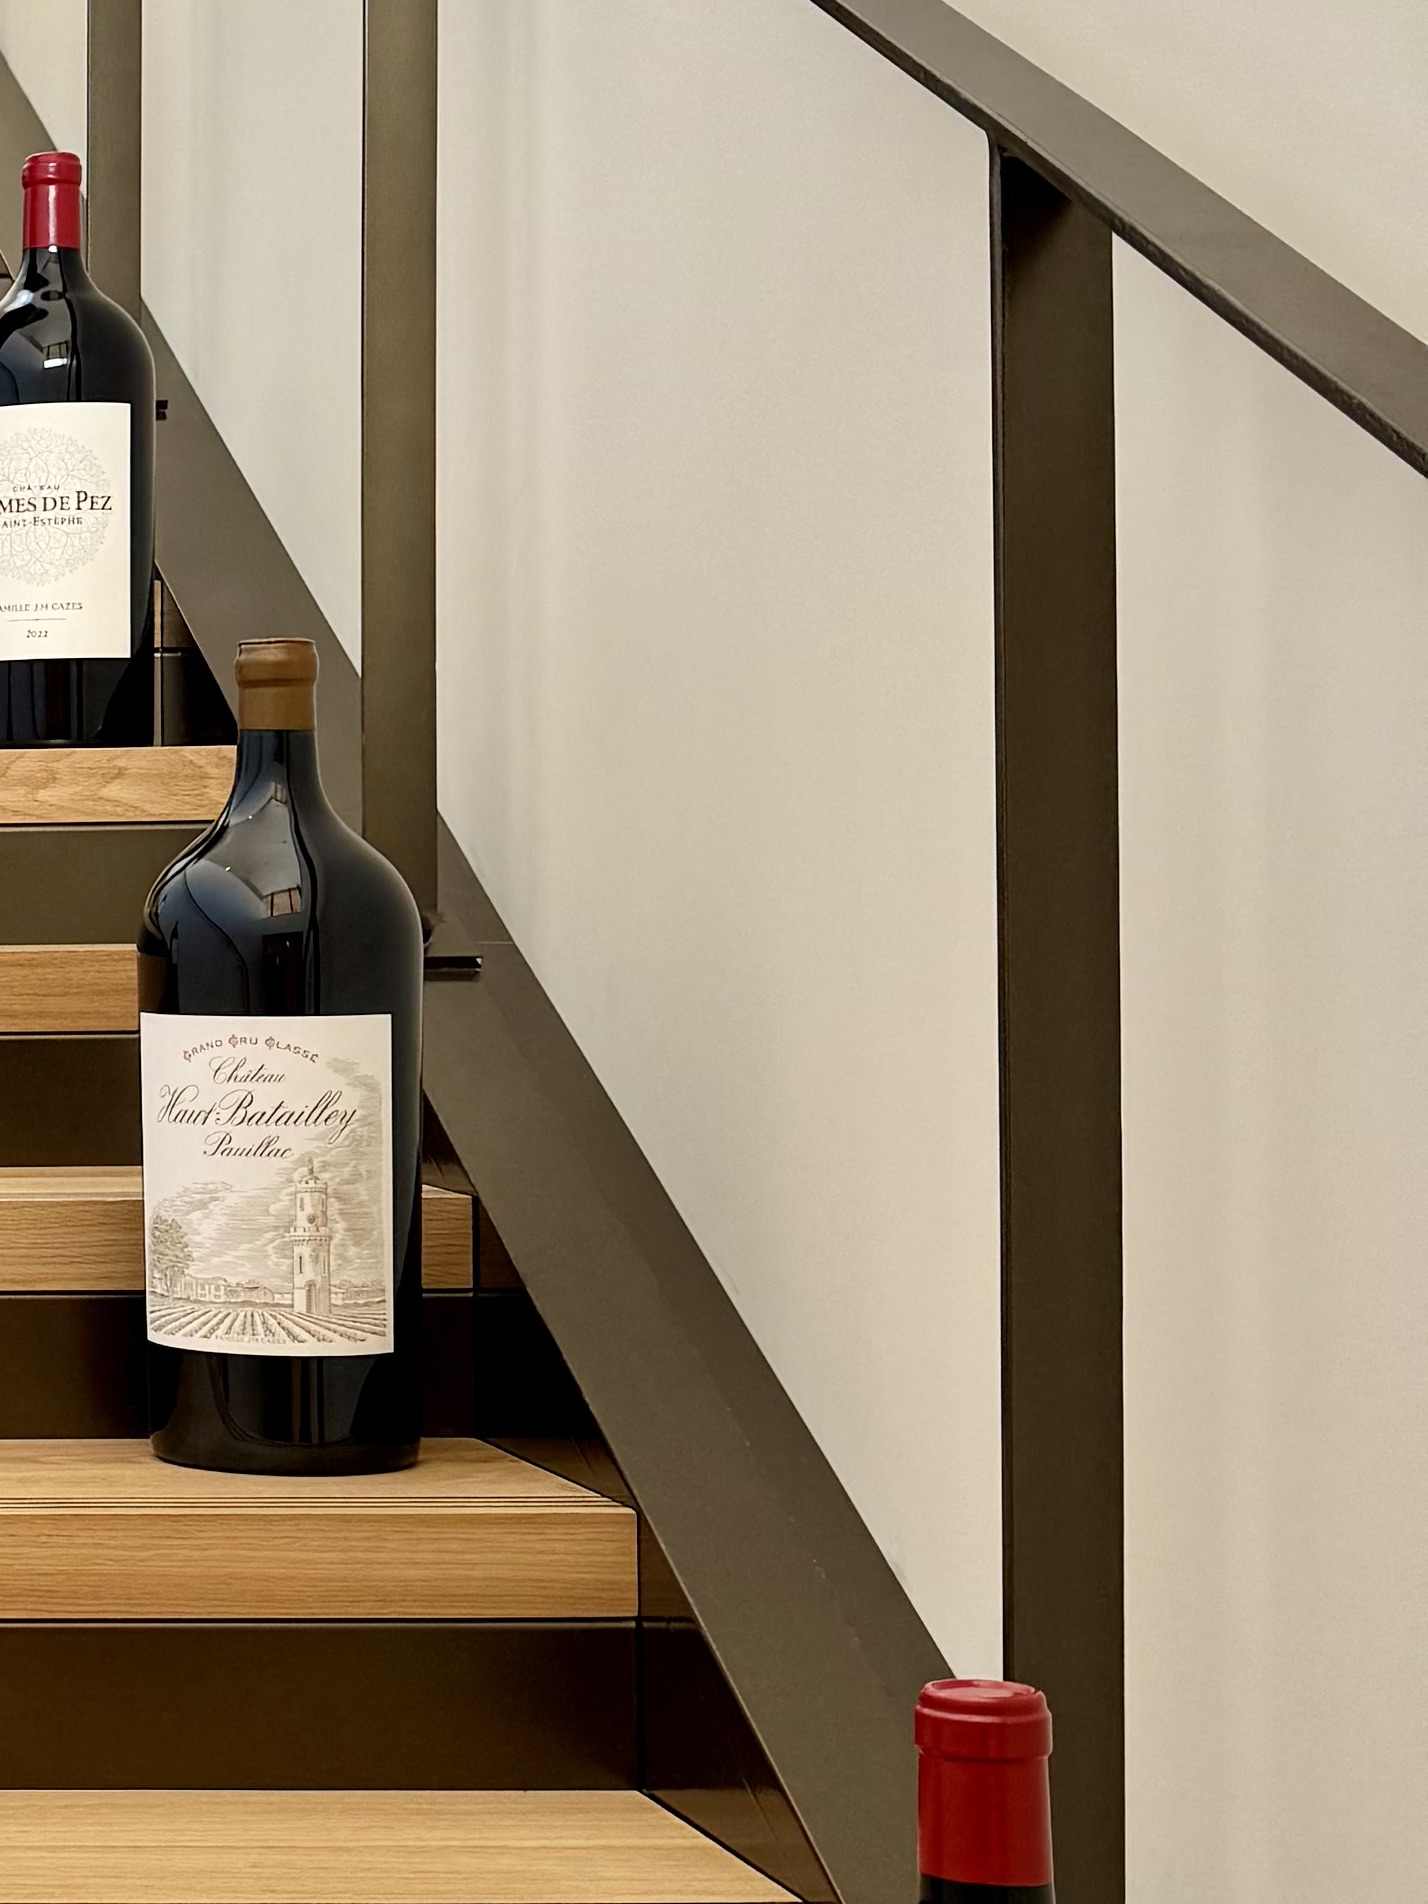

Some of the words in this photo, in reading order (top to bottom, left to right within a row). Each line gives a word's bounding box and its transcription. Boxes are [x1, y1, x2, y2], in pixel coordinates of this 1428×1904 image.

[42, 496, 70, 512] DE
[75, 490, 112, 510] PEZ
[26, 630, 48, 638] 2022
[183, 1039, 223, 1063] GRAND
[228, 1034, 258, 1048] CRU
[209, 1056, 288, 1085] Château
[203, 1131, 294, 1160] Pauillac
